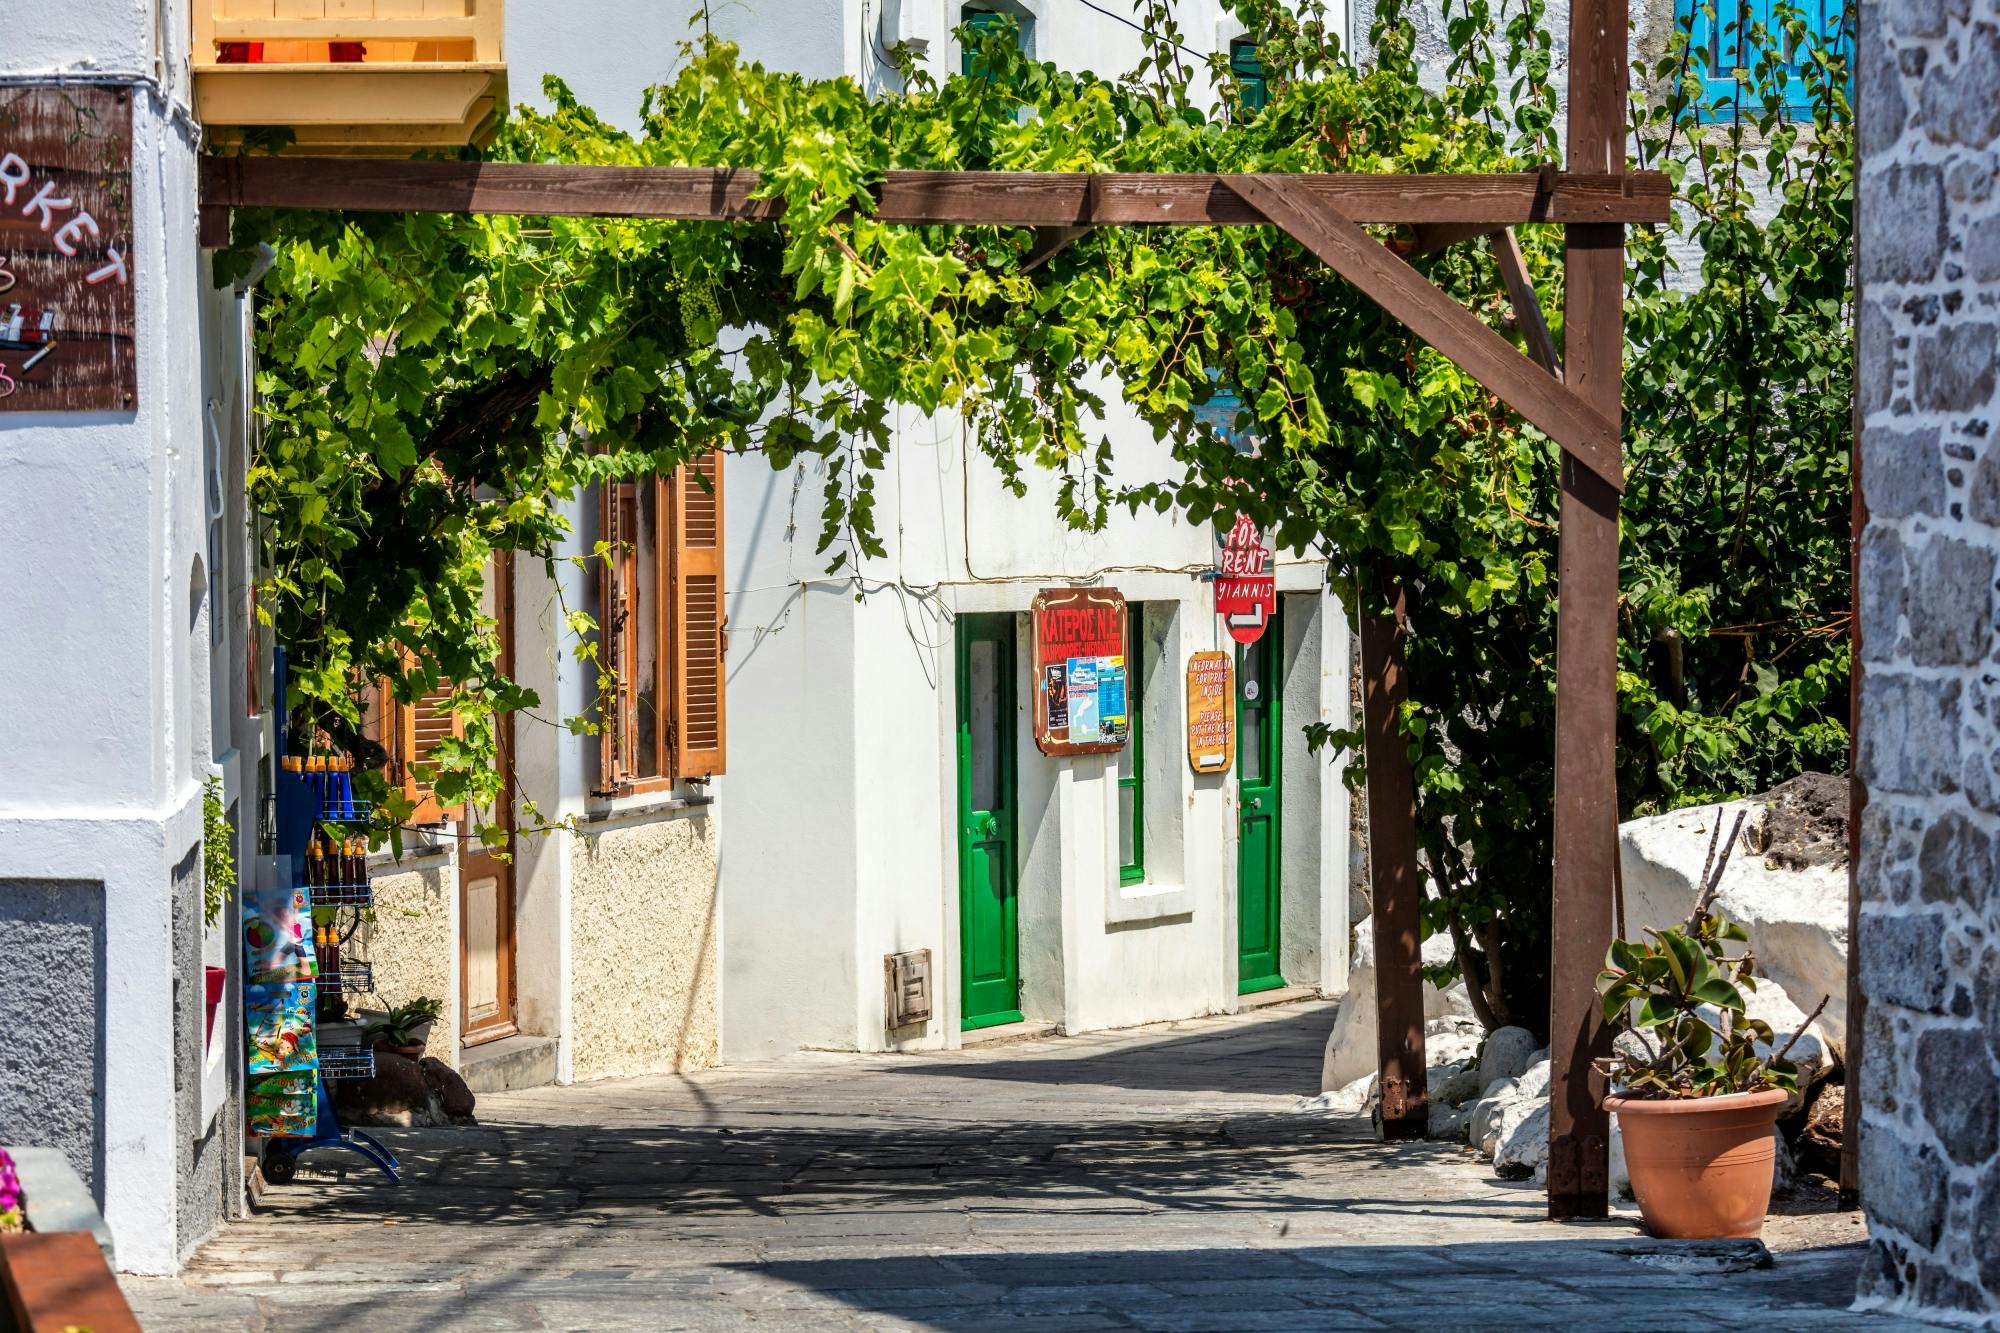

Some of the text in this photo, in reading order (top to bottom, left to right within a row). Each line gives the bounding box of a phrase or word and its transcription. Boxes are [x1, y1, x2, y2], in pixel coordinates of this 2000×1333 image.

[1228, 522, 1260, 547] FOR
[1223, 549, 1268, 574] RENT
[1217, 582, 1273, 601] YIANNIS
[1040, 609, 1095, 643] ΚΑΤΕΡΟΣ
[1191, 659, 1232, 671] INFORMATION
[1195, 673, 1208, 685] FOR
[1200, 684, 1222, 697] INSIDE
[1200, 711, 1222, 721] PLEASE
[1191, 724, 1203, 735] PUT
[1204, 722, 1215, 734] THE
[1196, 734, 1229, 747] IN THE BOX
